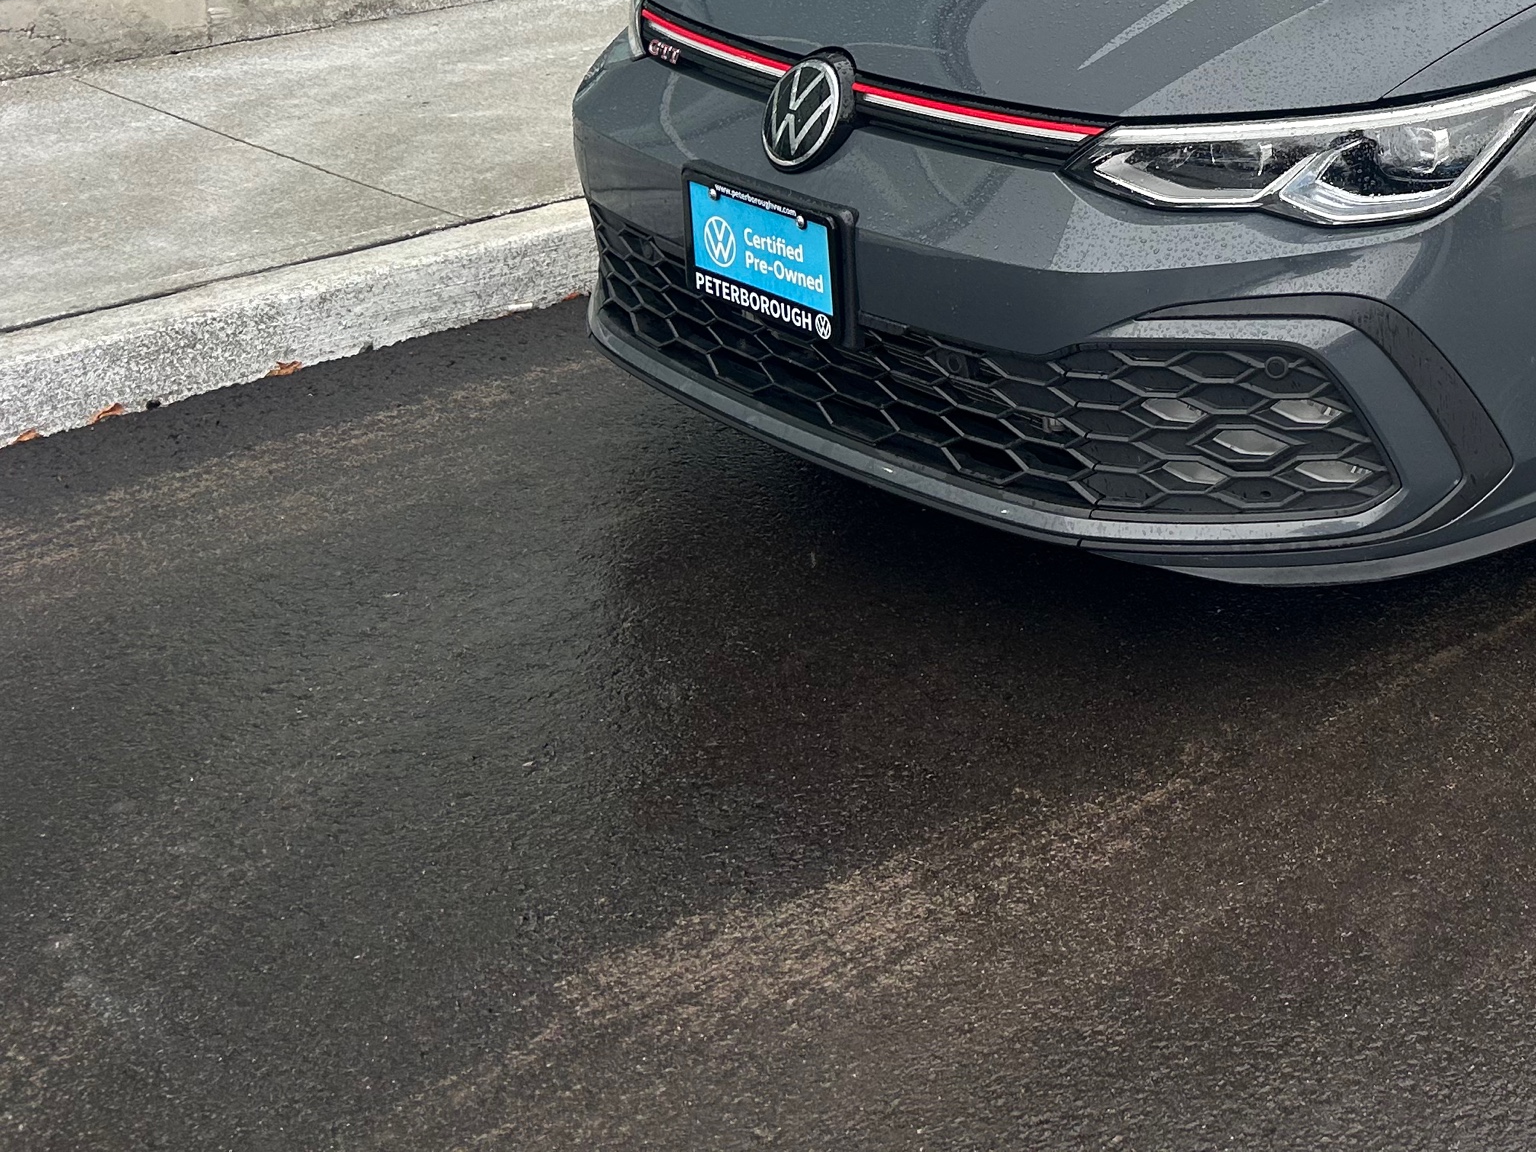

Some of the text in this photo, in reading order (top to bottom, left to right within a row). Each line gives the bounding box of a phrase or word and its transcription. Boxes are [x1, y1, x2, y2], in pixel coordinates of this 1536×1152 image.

[649, 39, 681, 65] GTI
[743, 227, 804, 263] Certified
[745, 251, 824, 294] Pre-Owned
[695, 272, 812, 332] PETERBOROUGH
